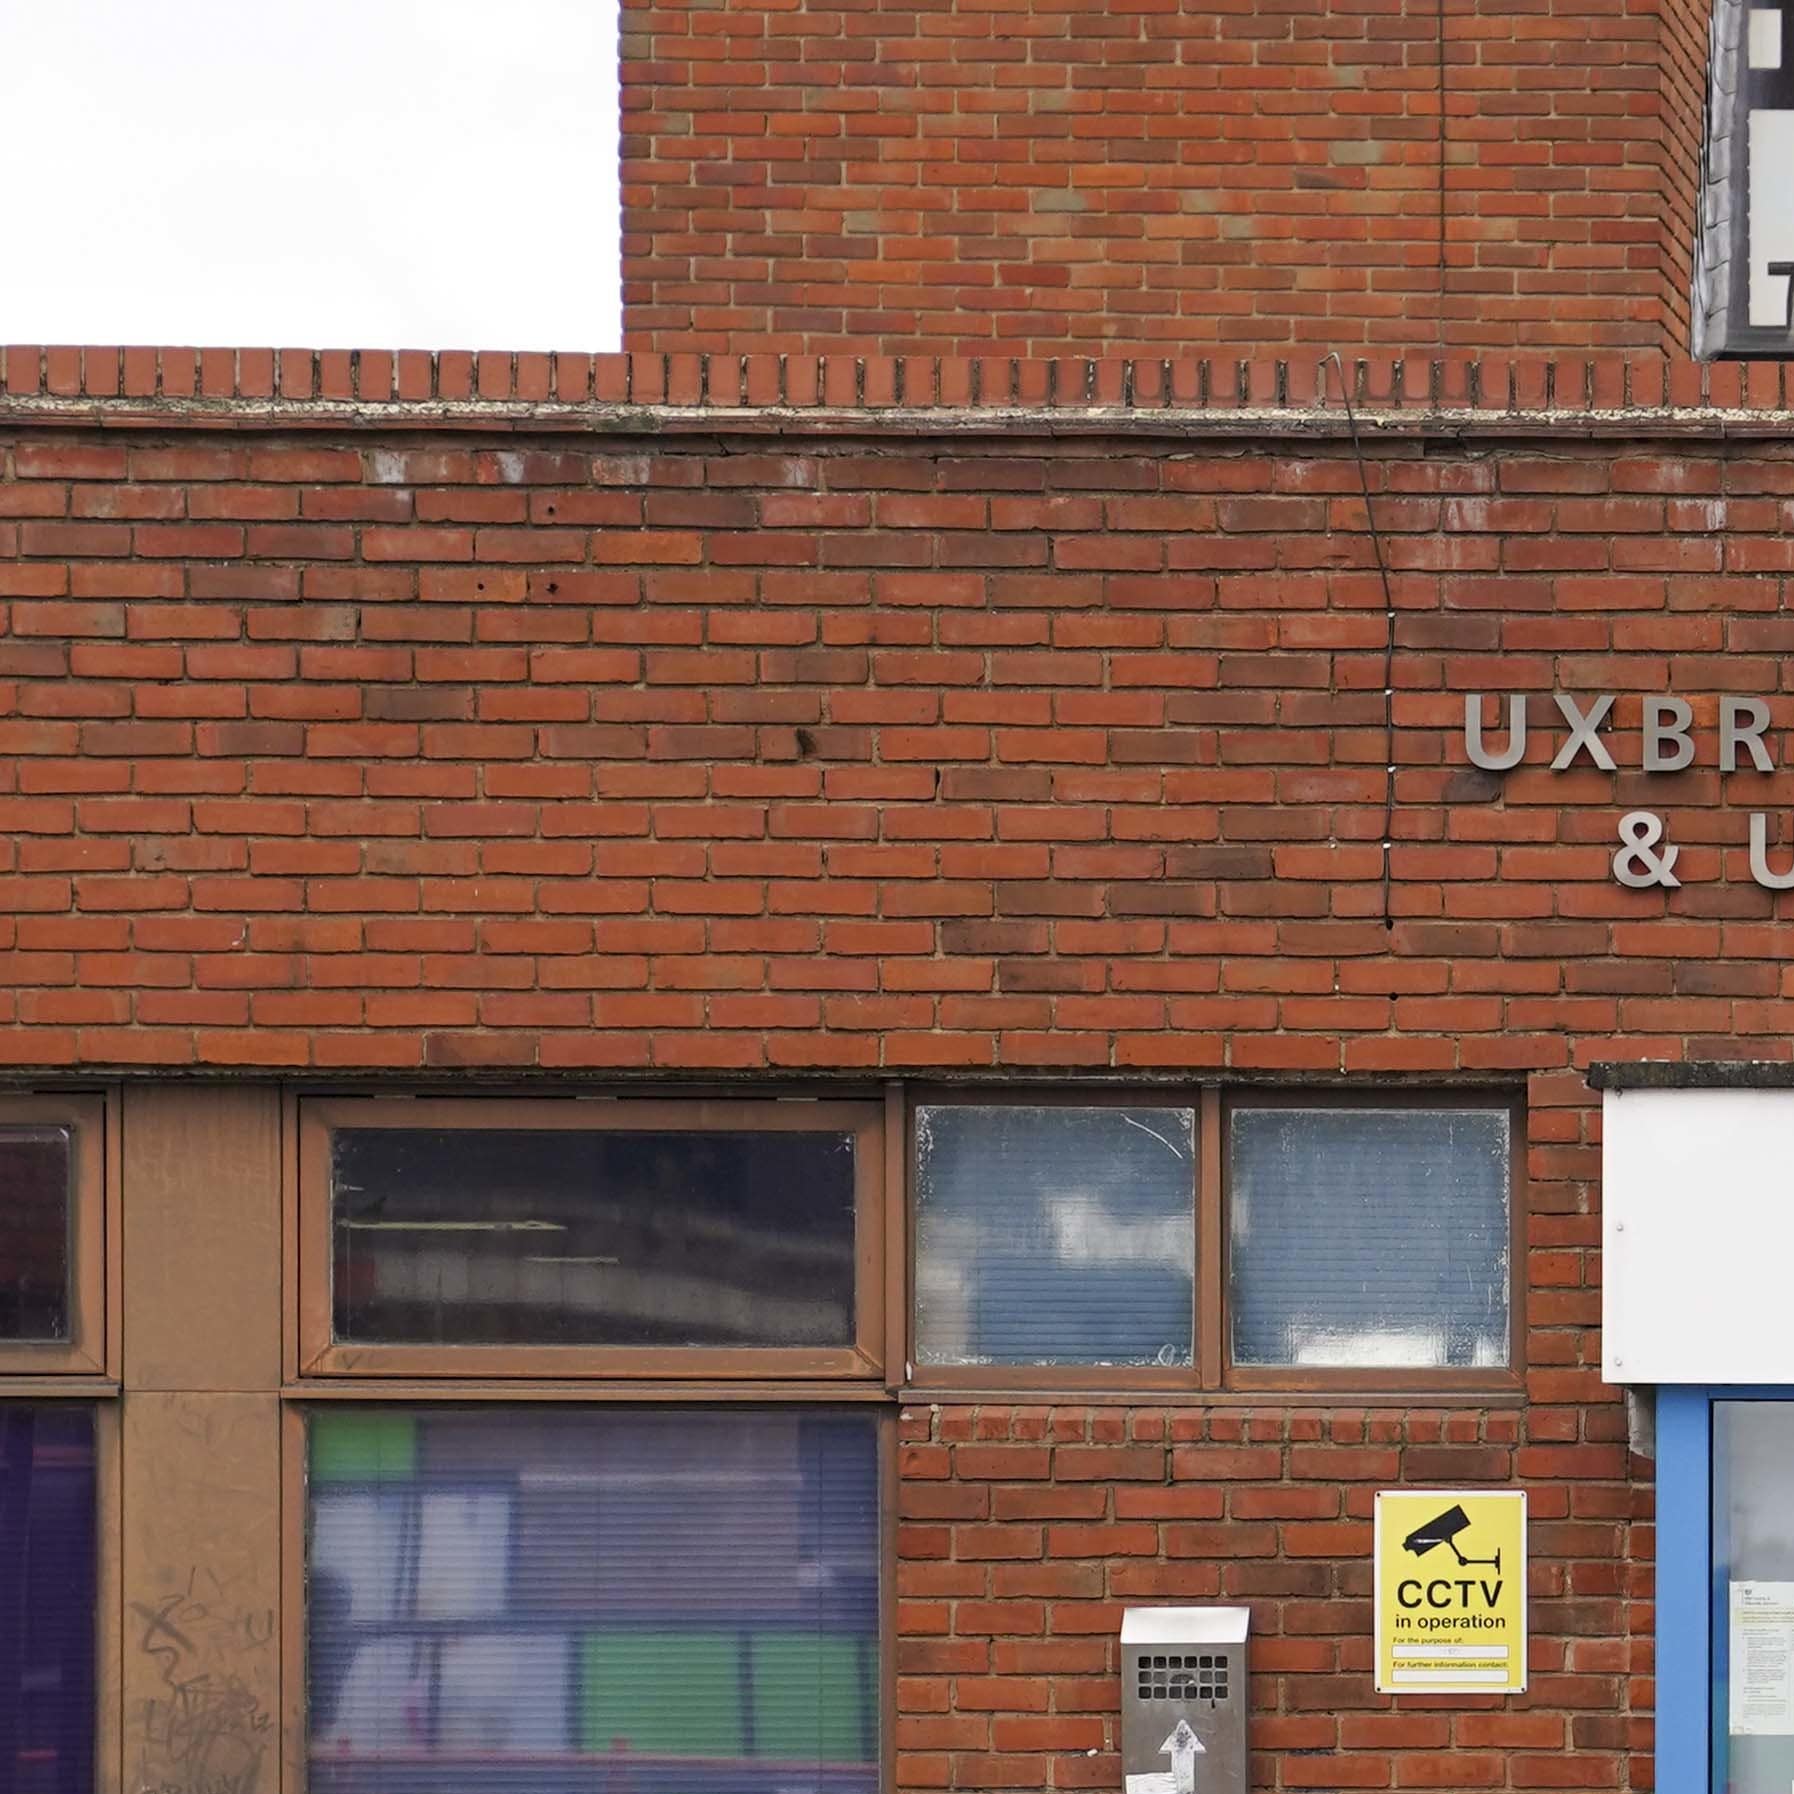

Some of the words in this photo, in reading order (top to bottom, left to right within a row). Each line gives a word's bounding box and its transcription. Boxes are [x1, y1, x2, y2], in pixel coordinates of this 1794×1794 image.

[1612, 810, 1682, 889] &
[1397, 1579, 1503, 1609] CCTV
[1395, 1613, 1412, 1629] in
[1417, 1613, 1506, 1631] operation
